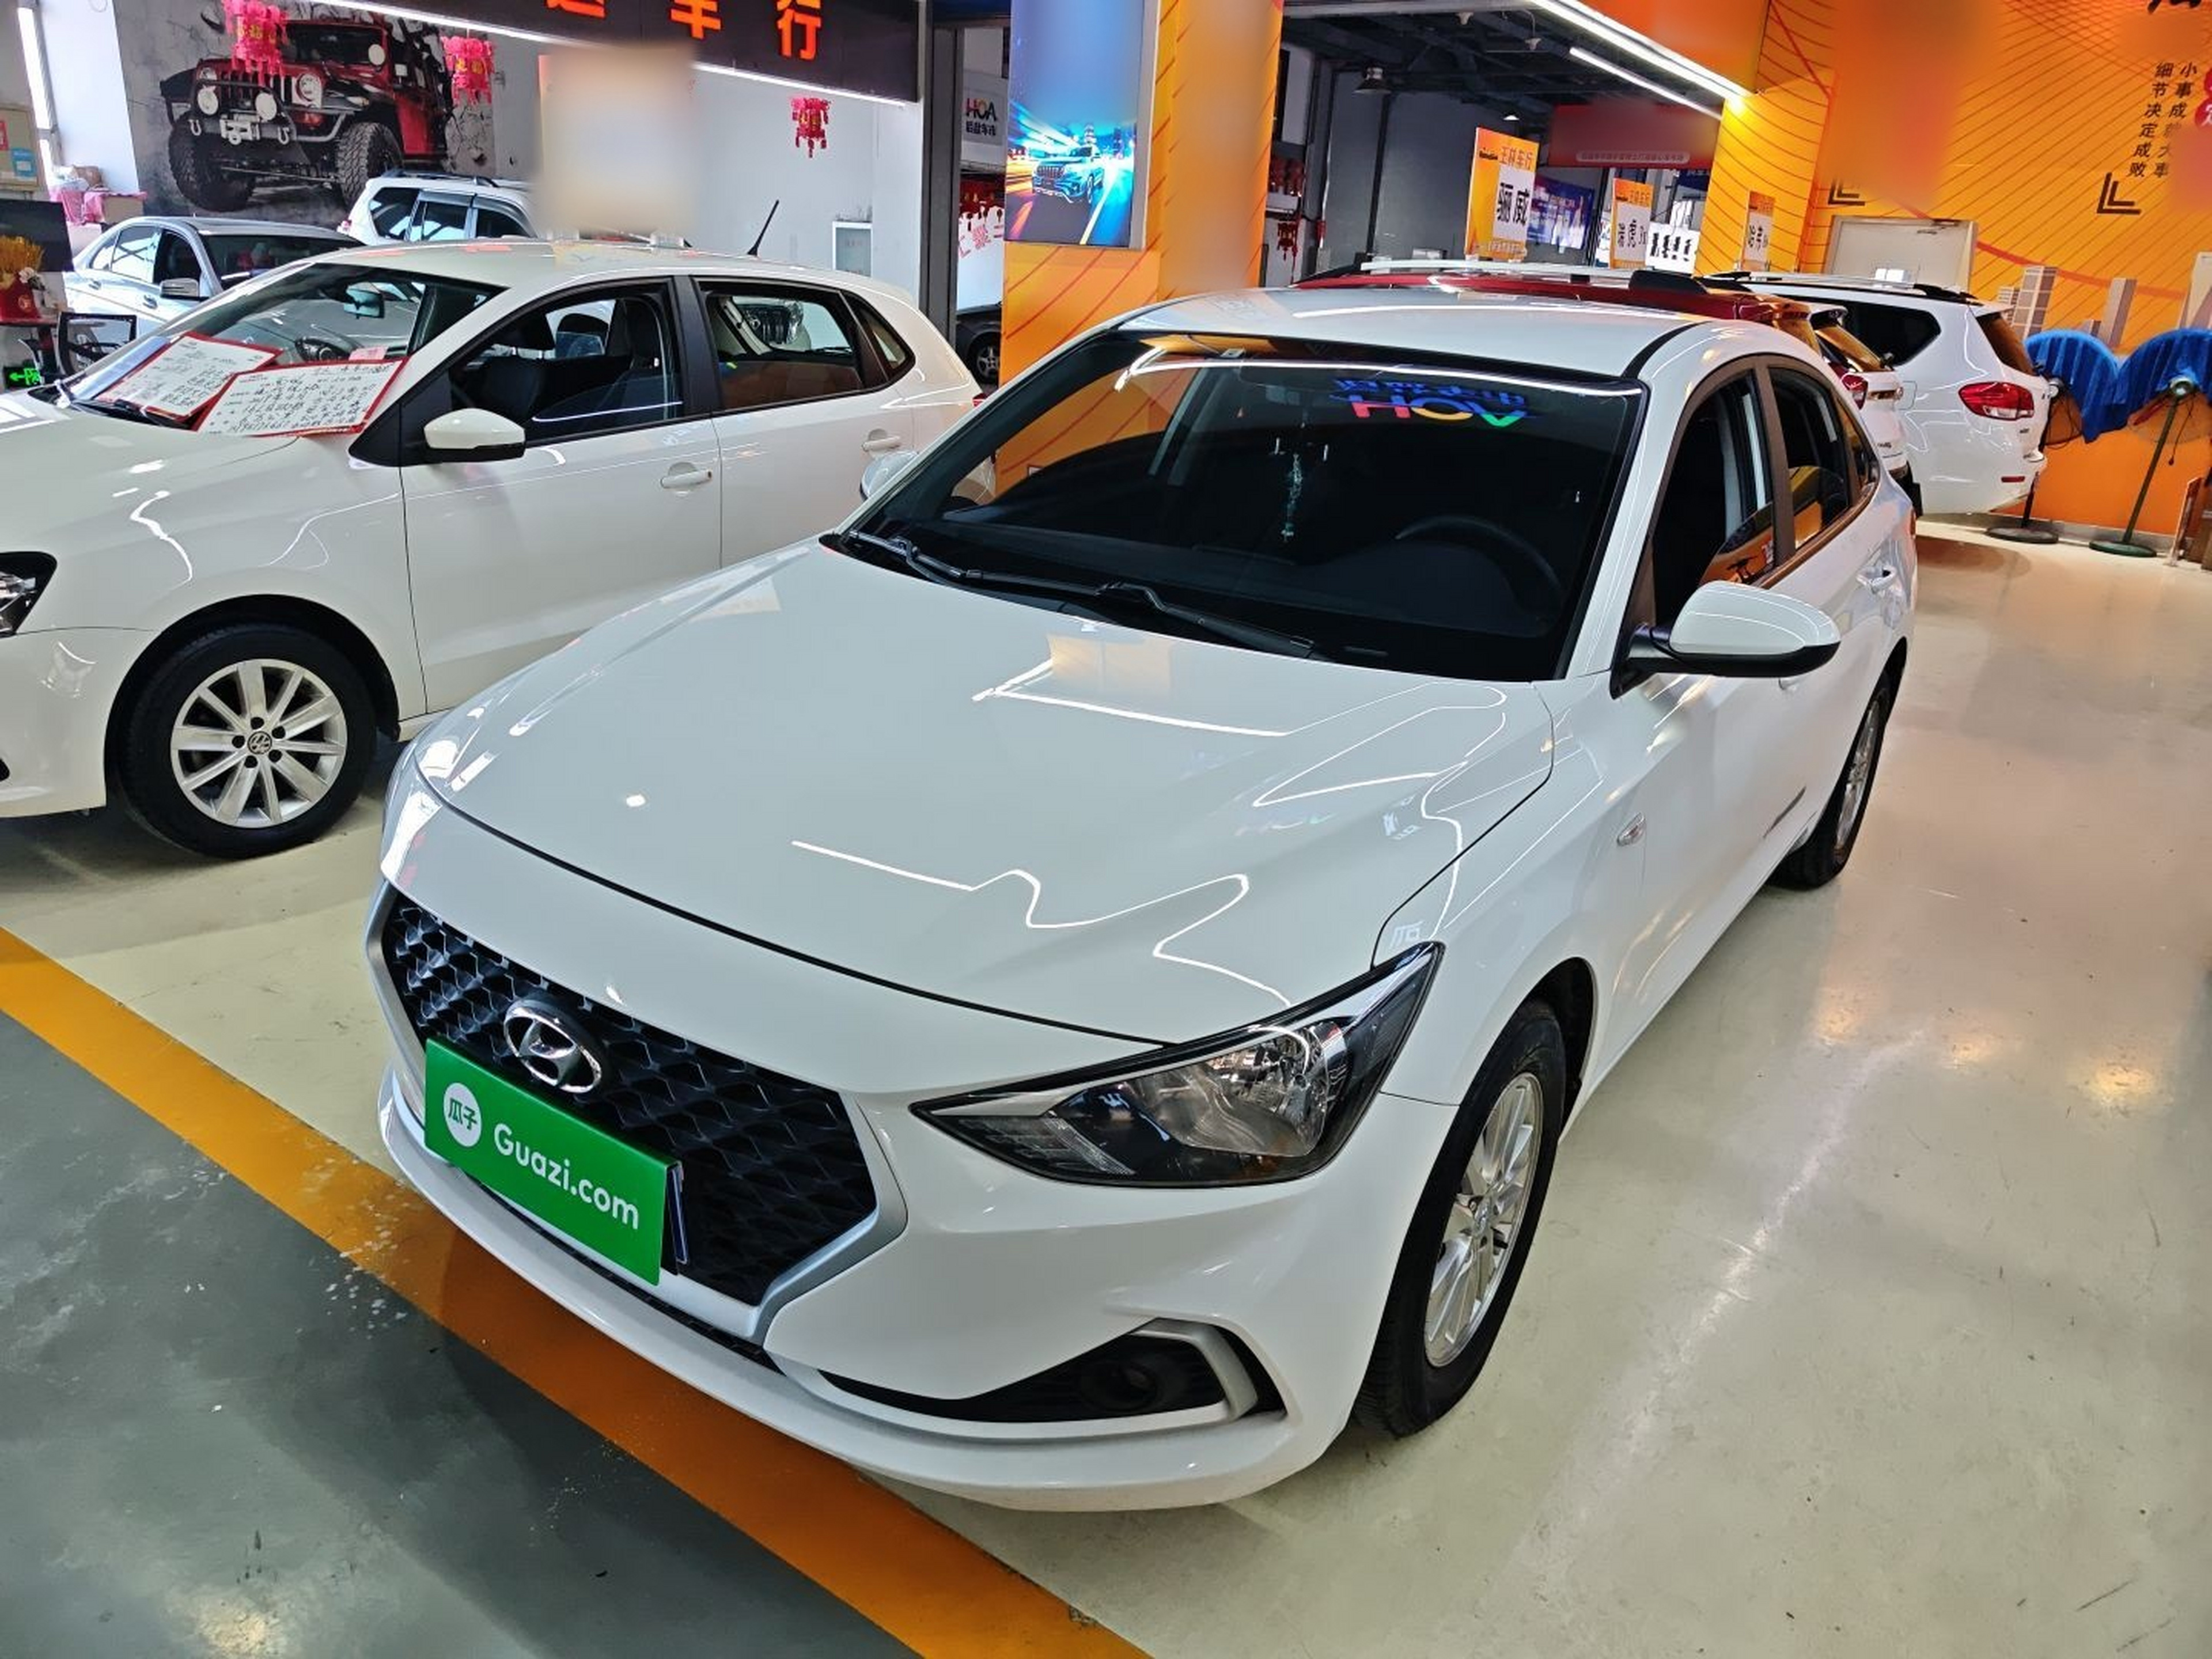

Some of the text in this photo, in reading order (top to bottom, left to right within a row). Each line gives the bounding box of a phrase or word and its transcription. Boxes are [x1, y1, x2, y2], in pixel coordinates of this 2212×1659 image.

[546, 0, 821, 60] 车行
[2126, 62, 2175, 177] 细节决定成败
[448, 1097, 478, 1131] 瓜子
[494, 1123, 639, 1230] Guazi.com
